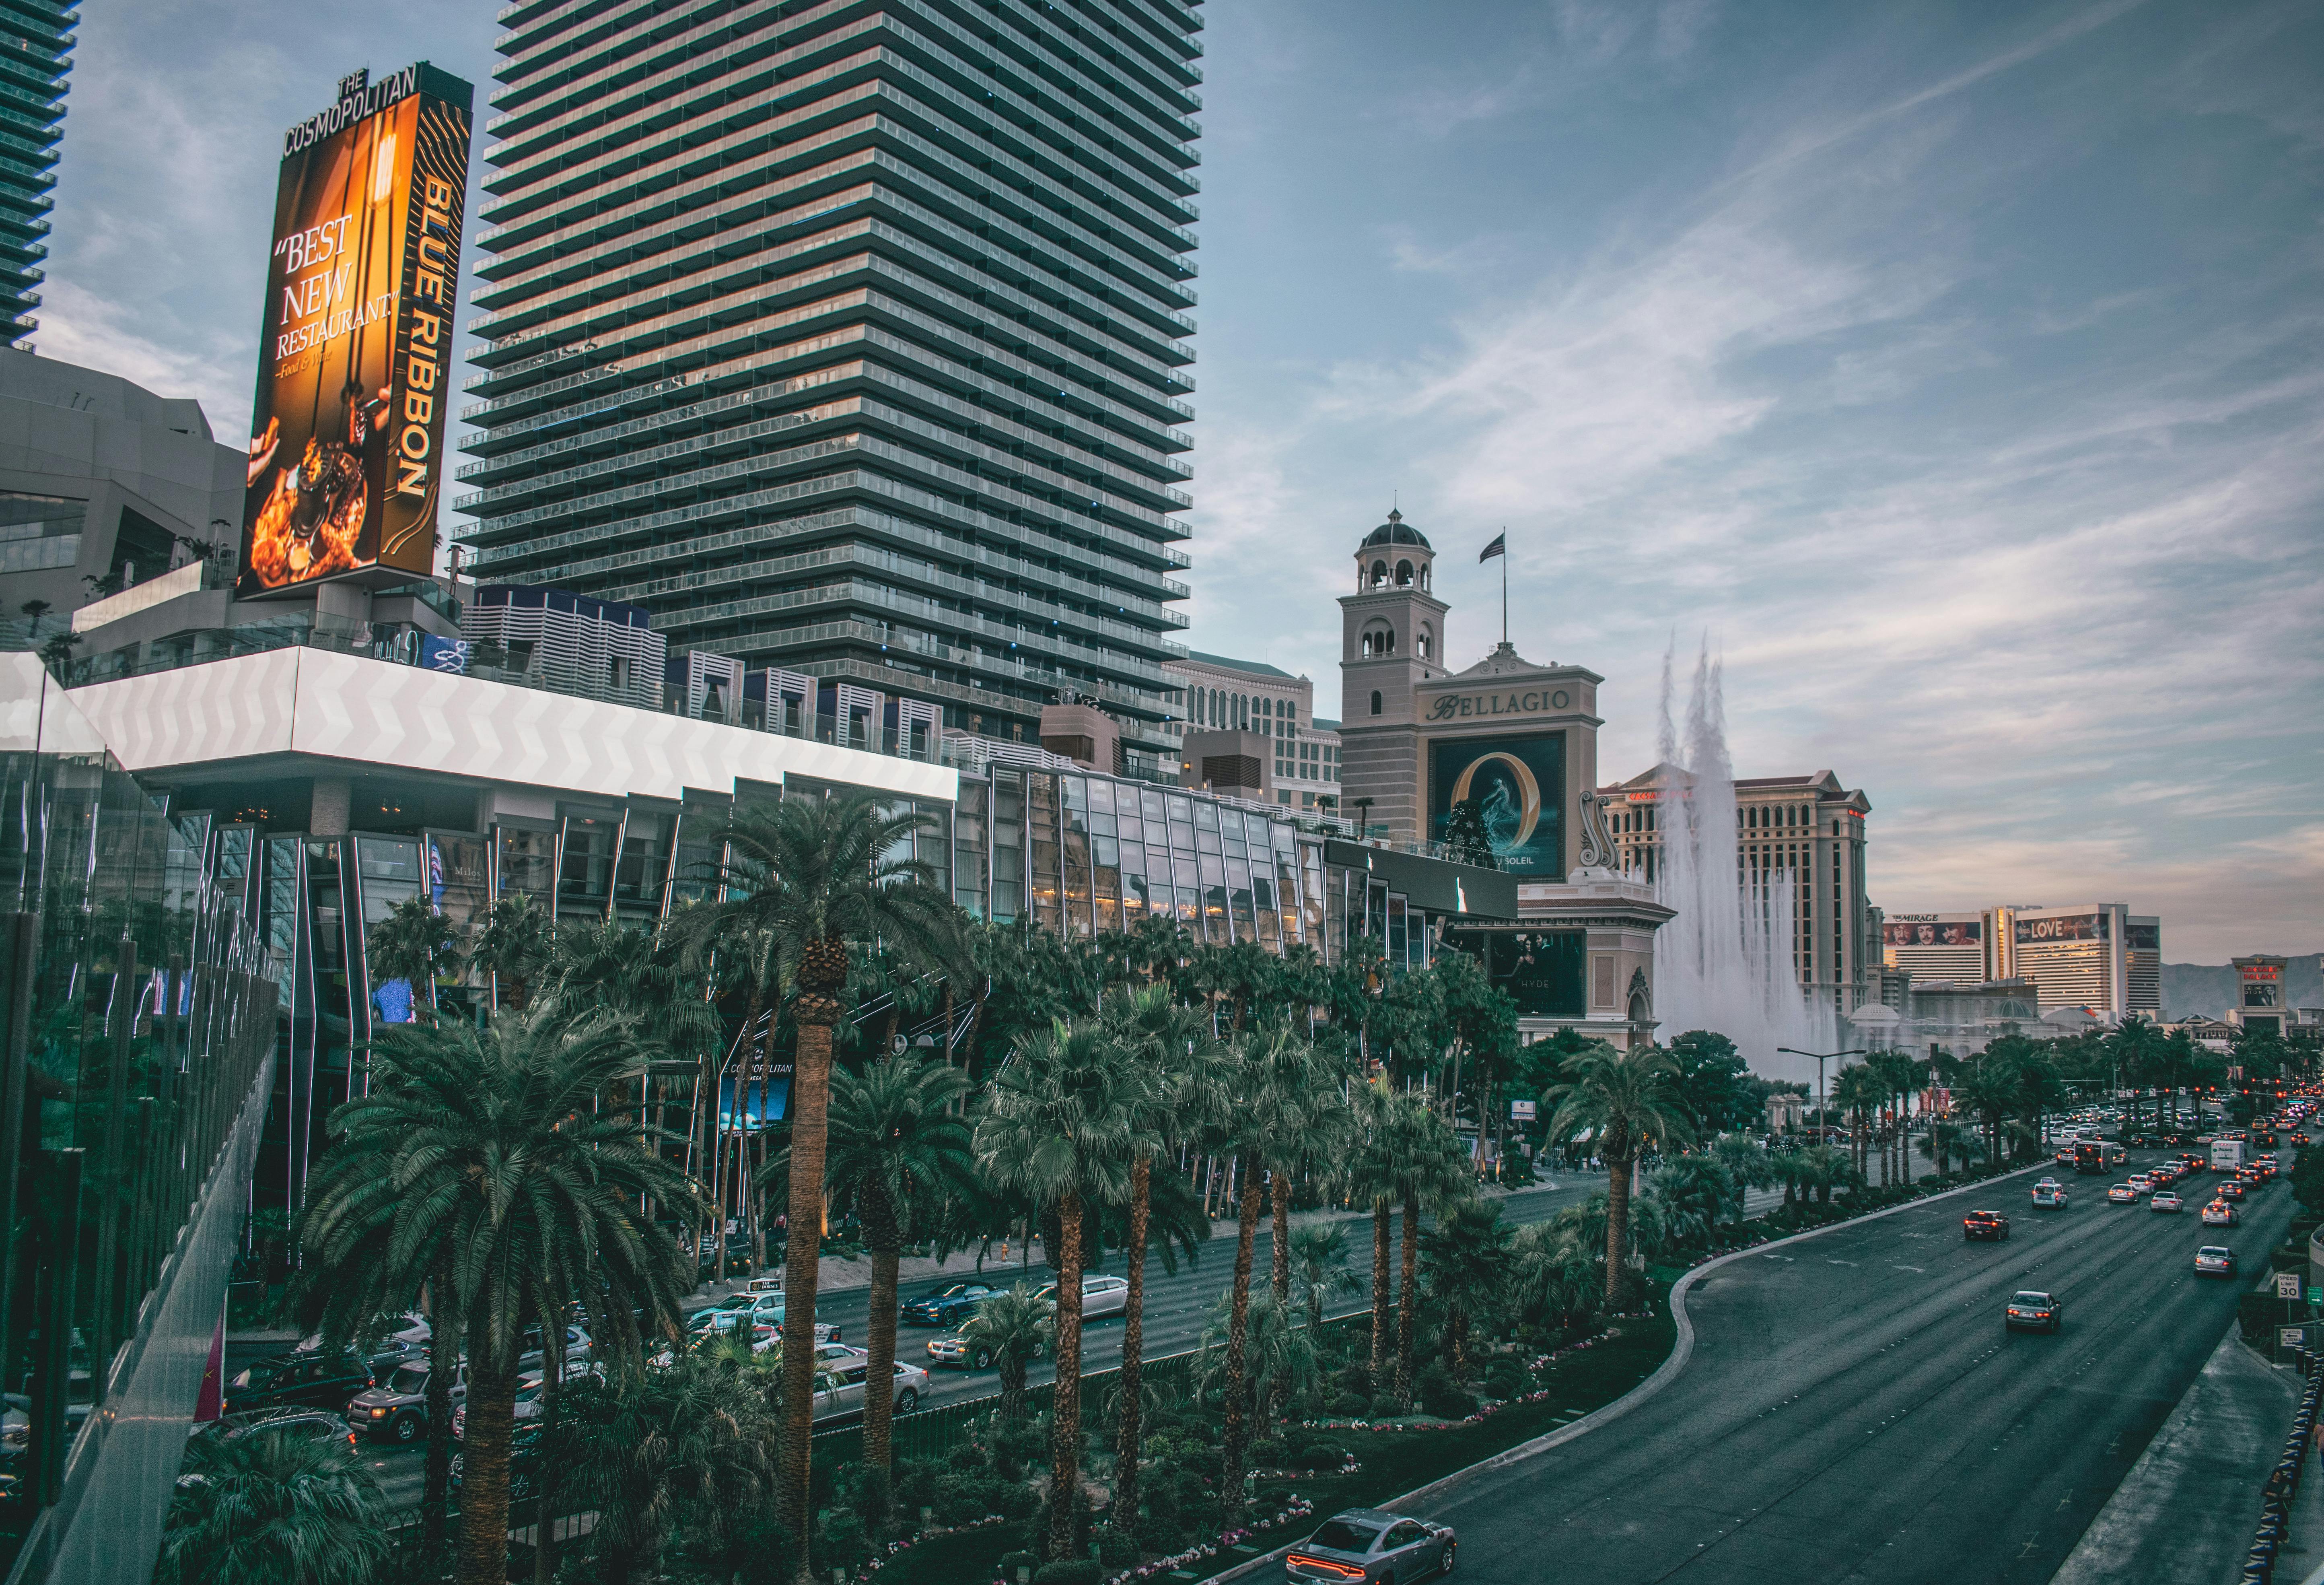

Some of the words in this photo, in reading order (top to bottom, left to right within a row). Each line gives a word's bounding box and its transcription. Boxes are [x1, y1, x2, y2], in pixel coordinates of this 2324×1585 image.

[338, 69, 365, 97] THE
[284, 62, 417, 157] COSMOPOLITAN
[414, 173, 452, 307] BLUE
[281, 262, 352, 326] NEW
[301, 355, 309, 370] &
[312, 350, 333, 366] Wine
[397, 307, 441, 499] RIBBON
[1425, 690, 1570, 720] BELLAGIO
[455, 866, 481, 876] Milos
[1895, 914, 1939, 922] MIRAGE
[2032, 921, 2063, 938] LOVE
[1521, 979, 1549, 988] HYDE
[2281, 1287, 2297, 1296] 30
